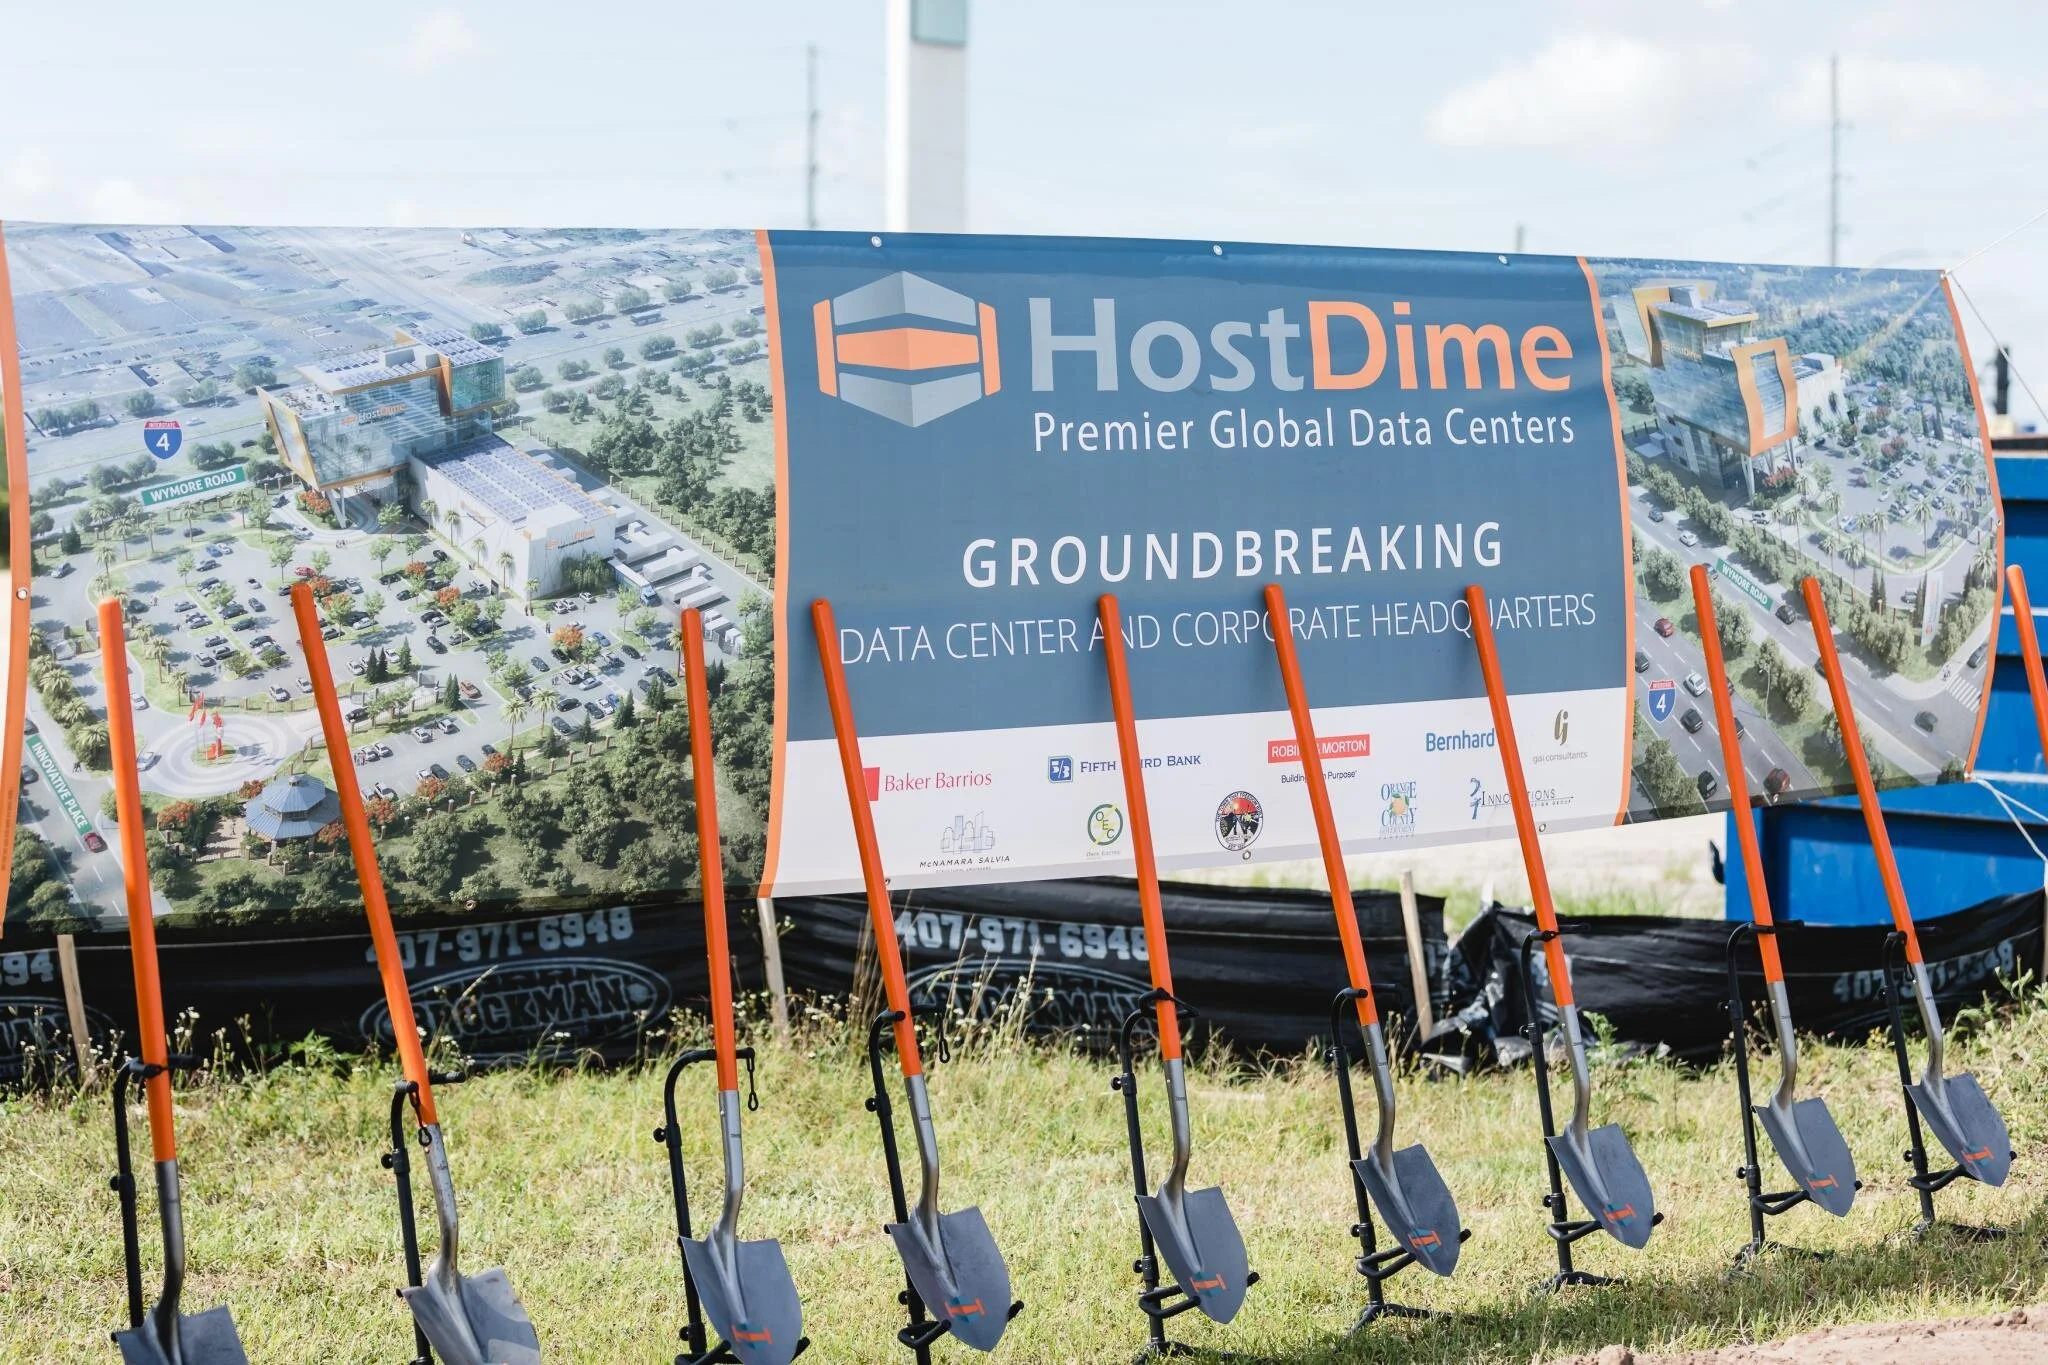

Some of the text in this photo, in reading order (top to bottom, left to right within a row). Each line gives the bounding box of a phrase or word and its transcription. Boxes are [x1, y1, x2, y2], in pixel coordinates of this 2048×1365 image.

[1029, 298, 1574, 393] HostDime
[155, 432, 171, 452] 4
[1034, 407, 1575, 453] Premier Global Data Centers
[150, 471, 237, 502] WYMORE ROAD
[962, 521, 1501, 588] GROUNDBREAKING
[1722, 563, 1768, 605] WYMORE ROAD
[840, 593, 1596, 665] DATA CENTER AND CORPORATE HEADQARTERS
[1656, 693, 1667, 713] 4
[1271, 744, 1301, 758] ROBI
[1321, 739, 1367, 754] MORTON
[1425, 728, 1496, 752] Bernhard
[1080, 755, 1202, 773] FIFTH IRD BANK
[1545, 751, 1589, 762] consultants
[32, 742, 88, 829] INNOVATIVE PLACE
[884, 770, 992, 792] Baker Barrios
[1381, 781, 1417, 801] ORANGE
[1482, 788, 1556, 806] INNOIONS
[978, 855, 1011, 864] SALVIA
[894, 911, 1149, 961] 407-971-6948
[0, 952, 54, 987] 94
